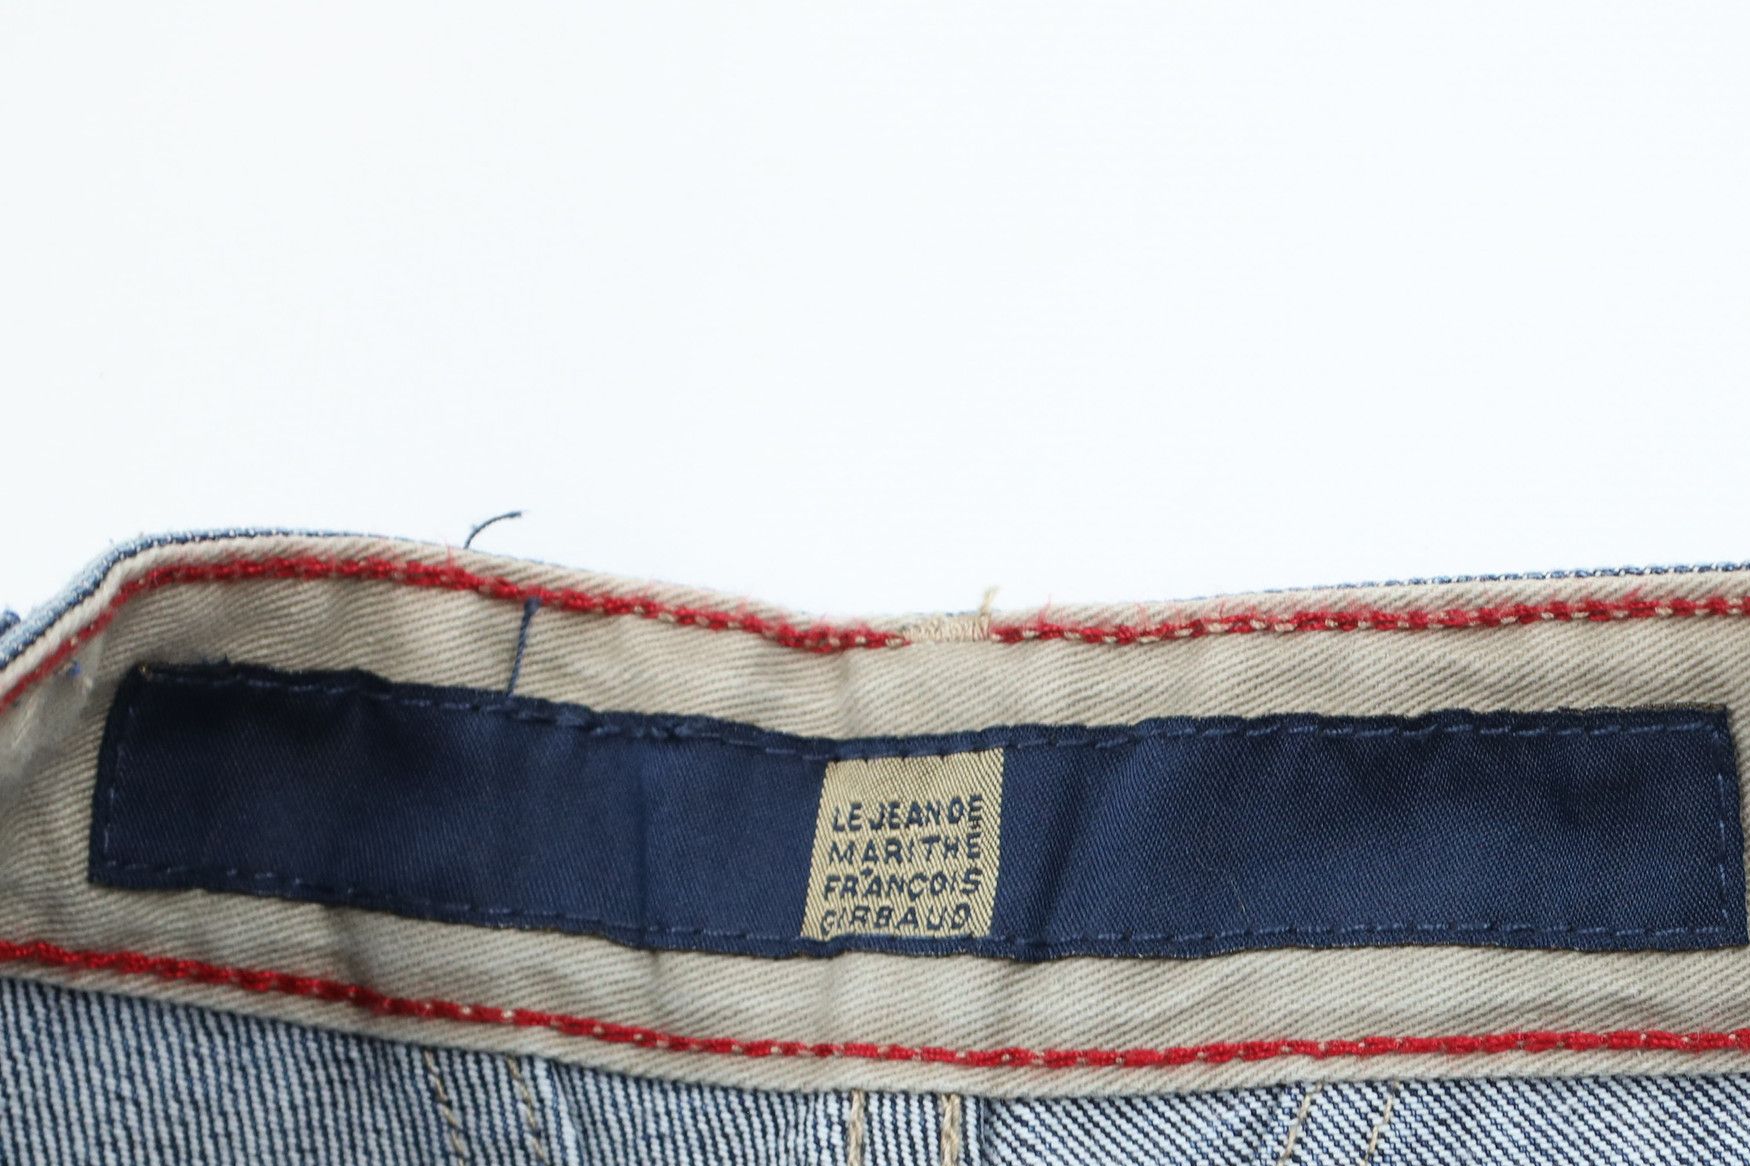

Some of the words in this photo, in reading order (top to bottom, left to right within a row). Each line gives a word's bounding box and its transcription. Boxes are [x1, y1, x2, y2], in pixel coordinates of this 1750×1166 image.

[832, 802, 862, 833] LE
[868, 800, 942, 830] JEAN
[947, 793, 983, 824] DE
[819, 902, 972, 936] GIRBAUD
